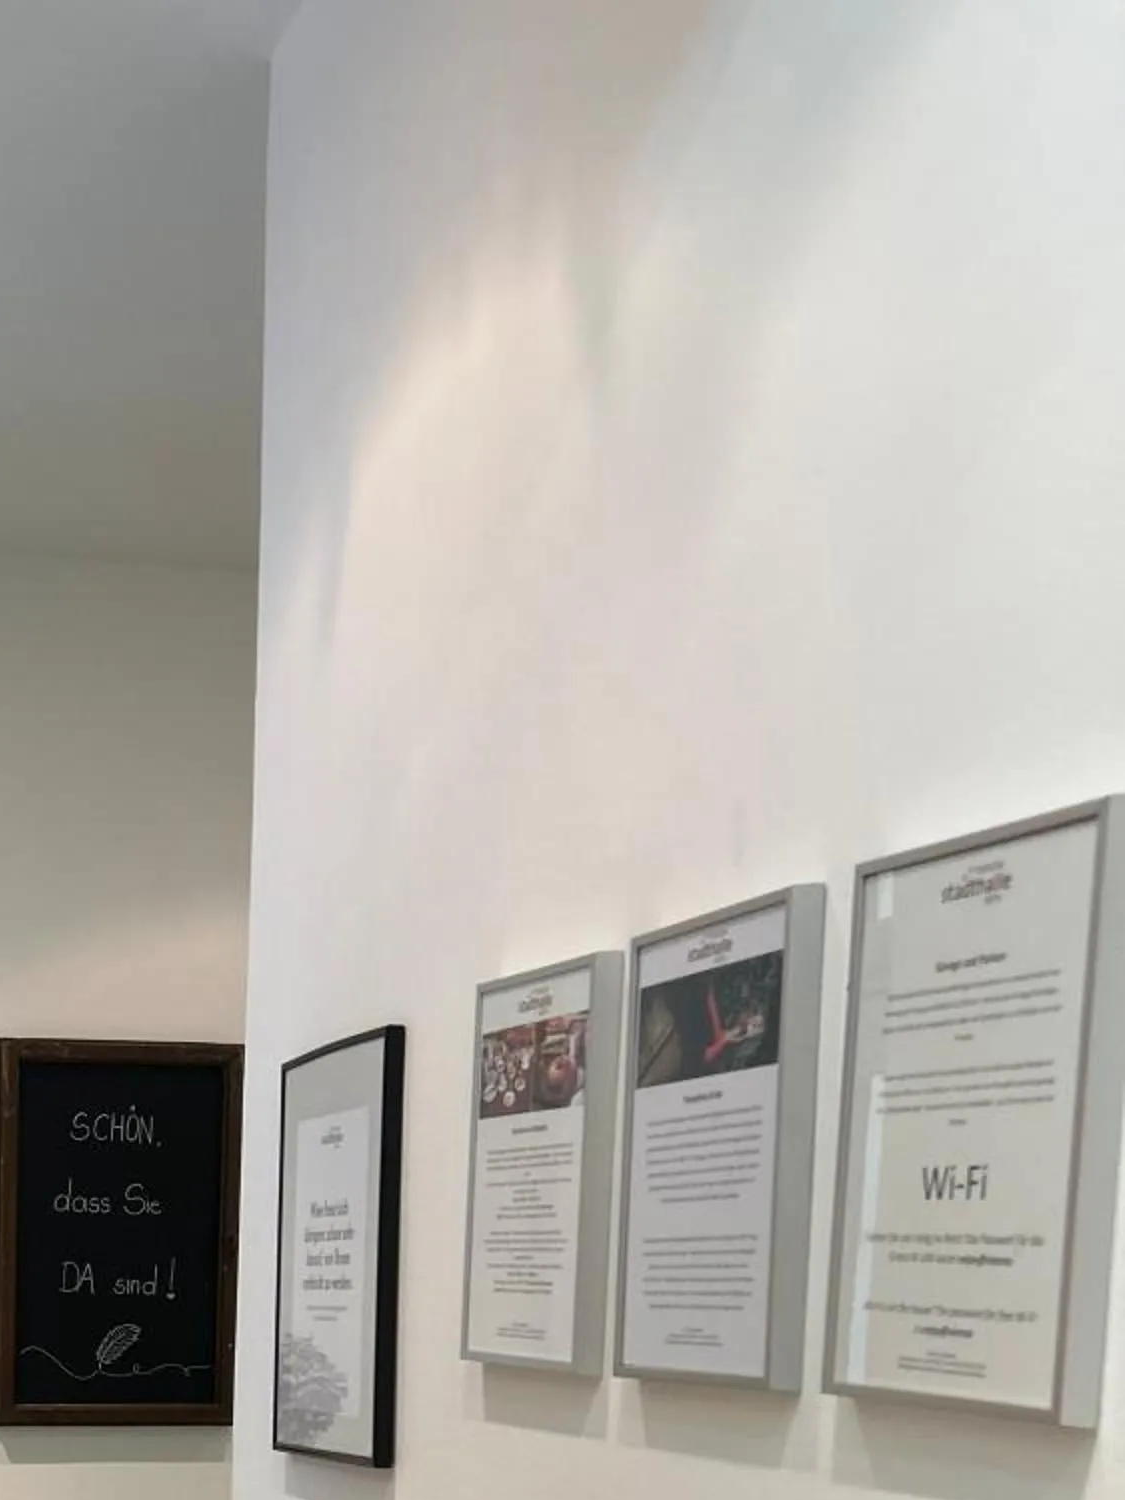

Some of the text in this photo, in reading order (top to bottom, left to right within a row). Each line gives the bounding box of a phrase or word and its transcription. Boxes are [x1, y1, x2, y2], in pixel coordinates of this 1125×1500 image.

[53, 1177, 162, 1215] dass Sie
[922, 1163, 989, 1200] Wi-Fi
[59, 1261, 95, 1294] DA
